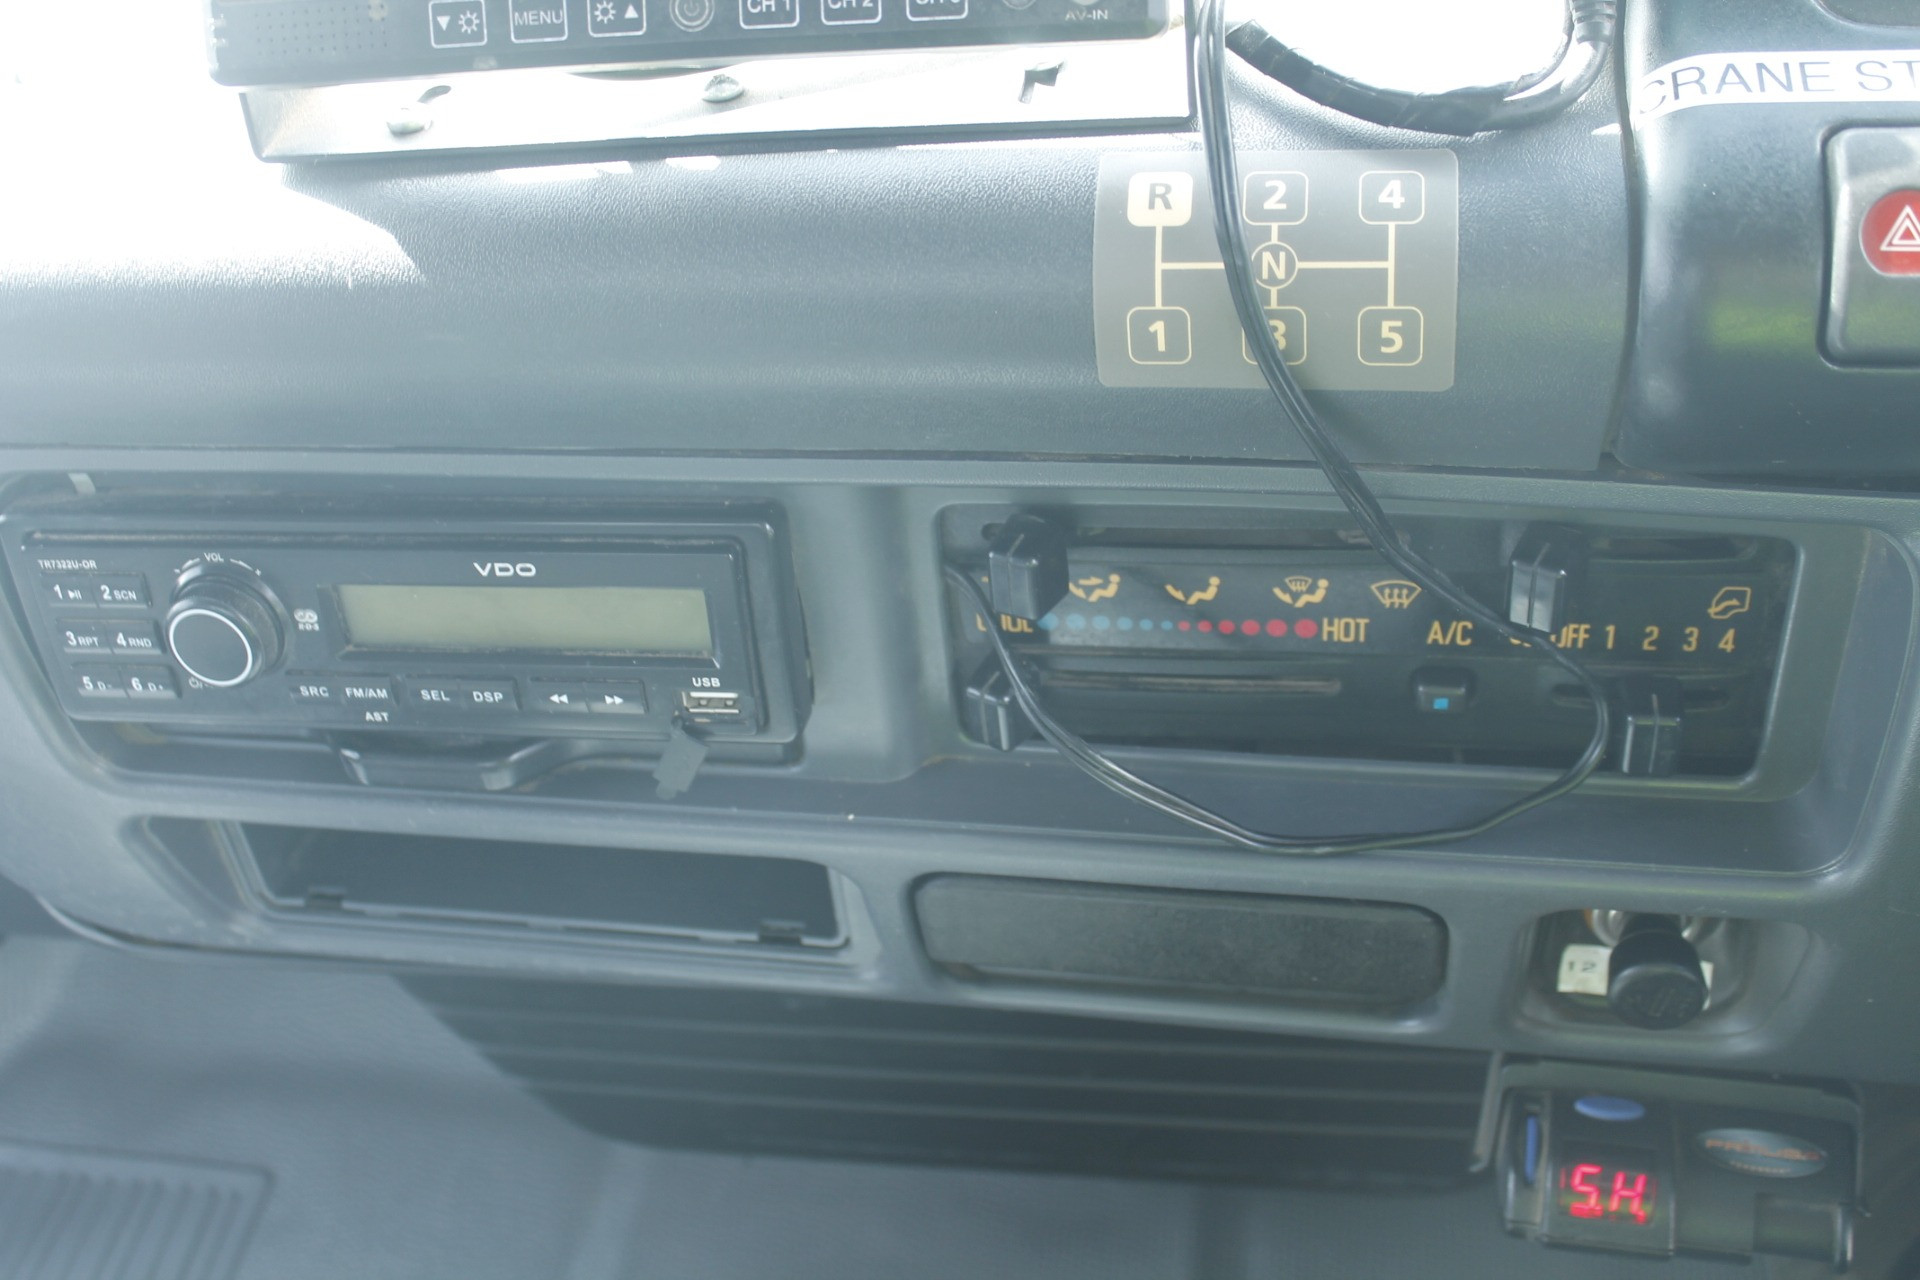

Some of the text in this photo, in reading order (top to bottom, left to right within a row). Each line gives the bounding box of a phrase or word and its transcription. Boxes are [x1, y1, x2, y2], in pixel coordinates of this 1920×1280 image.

[747, 0, 776, 13] CH
[1065, 9, 1108, 21] AV-IN
[514, 9, 564, 26] MENU
[1639, 62, 1835, 114] CRANE
[1148, 182, 1173, 210] R
[1262, 180, 1288, 210] 2
[1378, 179, 1405, 209] 4
[1261, 251, 1286, 280] N
[1148, 320, 1166, 352] 1
[1380, 320, 1403, 354] 5
[204, 552, 224, 563] VOL
[473, 562, 537, 577] VDO
[53, 584, 63, 600] 1
[100, 584, 137, 601] 2 SCN
[1322, 617, 1370, 643] HOT
[1427, 621, 1474, 646] A/C
[1605, 624, 1616, 650] 1
[1642, 626, 1659, 651] 2
[1682, 627, 1699, 652] 3
[1718, 628, 1736, 653] 4
[66, 631, 99, 648] 3 RPT
[116, 632, 152, 649] 4 RND
[82, 676, 93, 691] 5
[131, 677, 143, 692] 6
[300, 685, 329, 697] SRC
[692, 677, 721, 688] USB
[345, 686, 388, 699] FM/AM
[420, 689, 450, 702] SEL
[473, 690, 503, 703] DSP
[365, 711, 389, 723] AST
